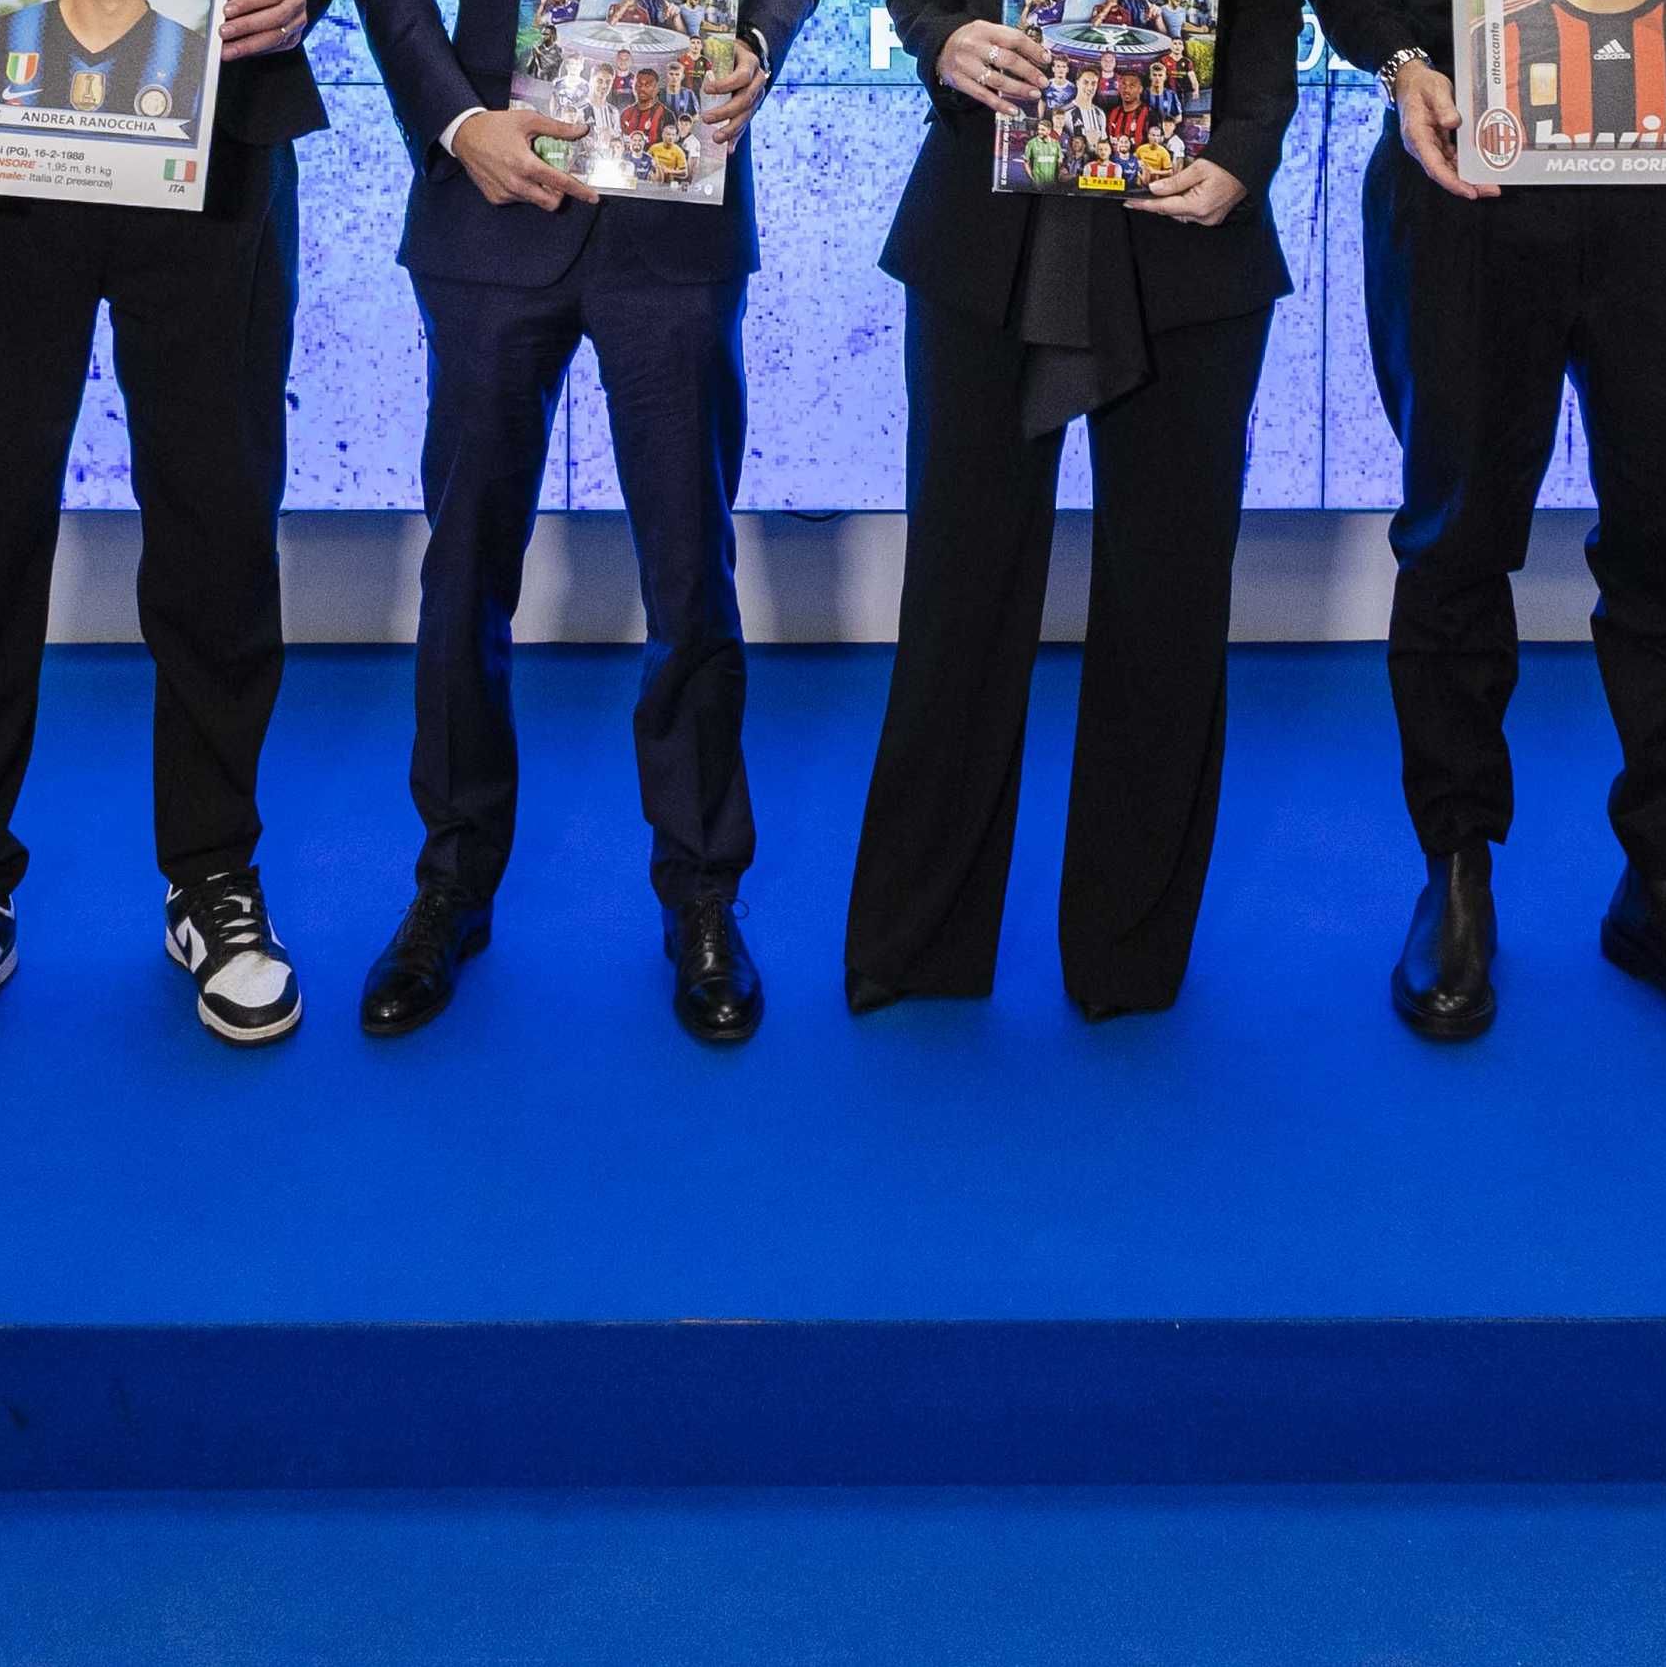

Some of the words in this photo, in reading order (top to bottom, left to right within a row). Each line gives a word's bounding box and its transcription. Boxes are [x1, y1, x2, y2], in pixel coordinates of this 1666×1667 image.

[1493, 21, 1502, 86] attaccante
[1593, 52, 1632, 61] adidas
[20, 111, 76, 126] ANDREA
[79, 116, 157, 133] RANOCCHIA
[6, 145, 32, 159] (PG),
[84, 165, 97, 175] 81
[99, 166, 112, 178] kg
[1545, 157, 1616, 173] MARCO
[29, 172, 53, 184] Italia
[167, 184, 186, 194] ITA
